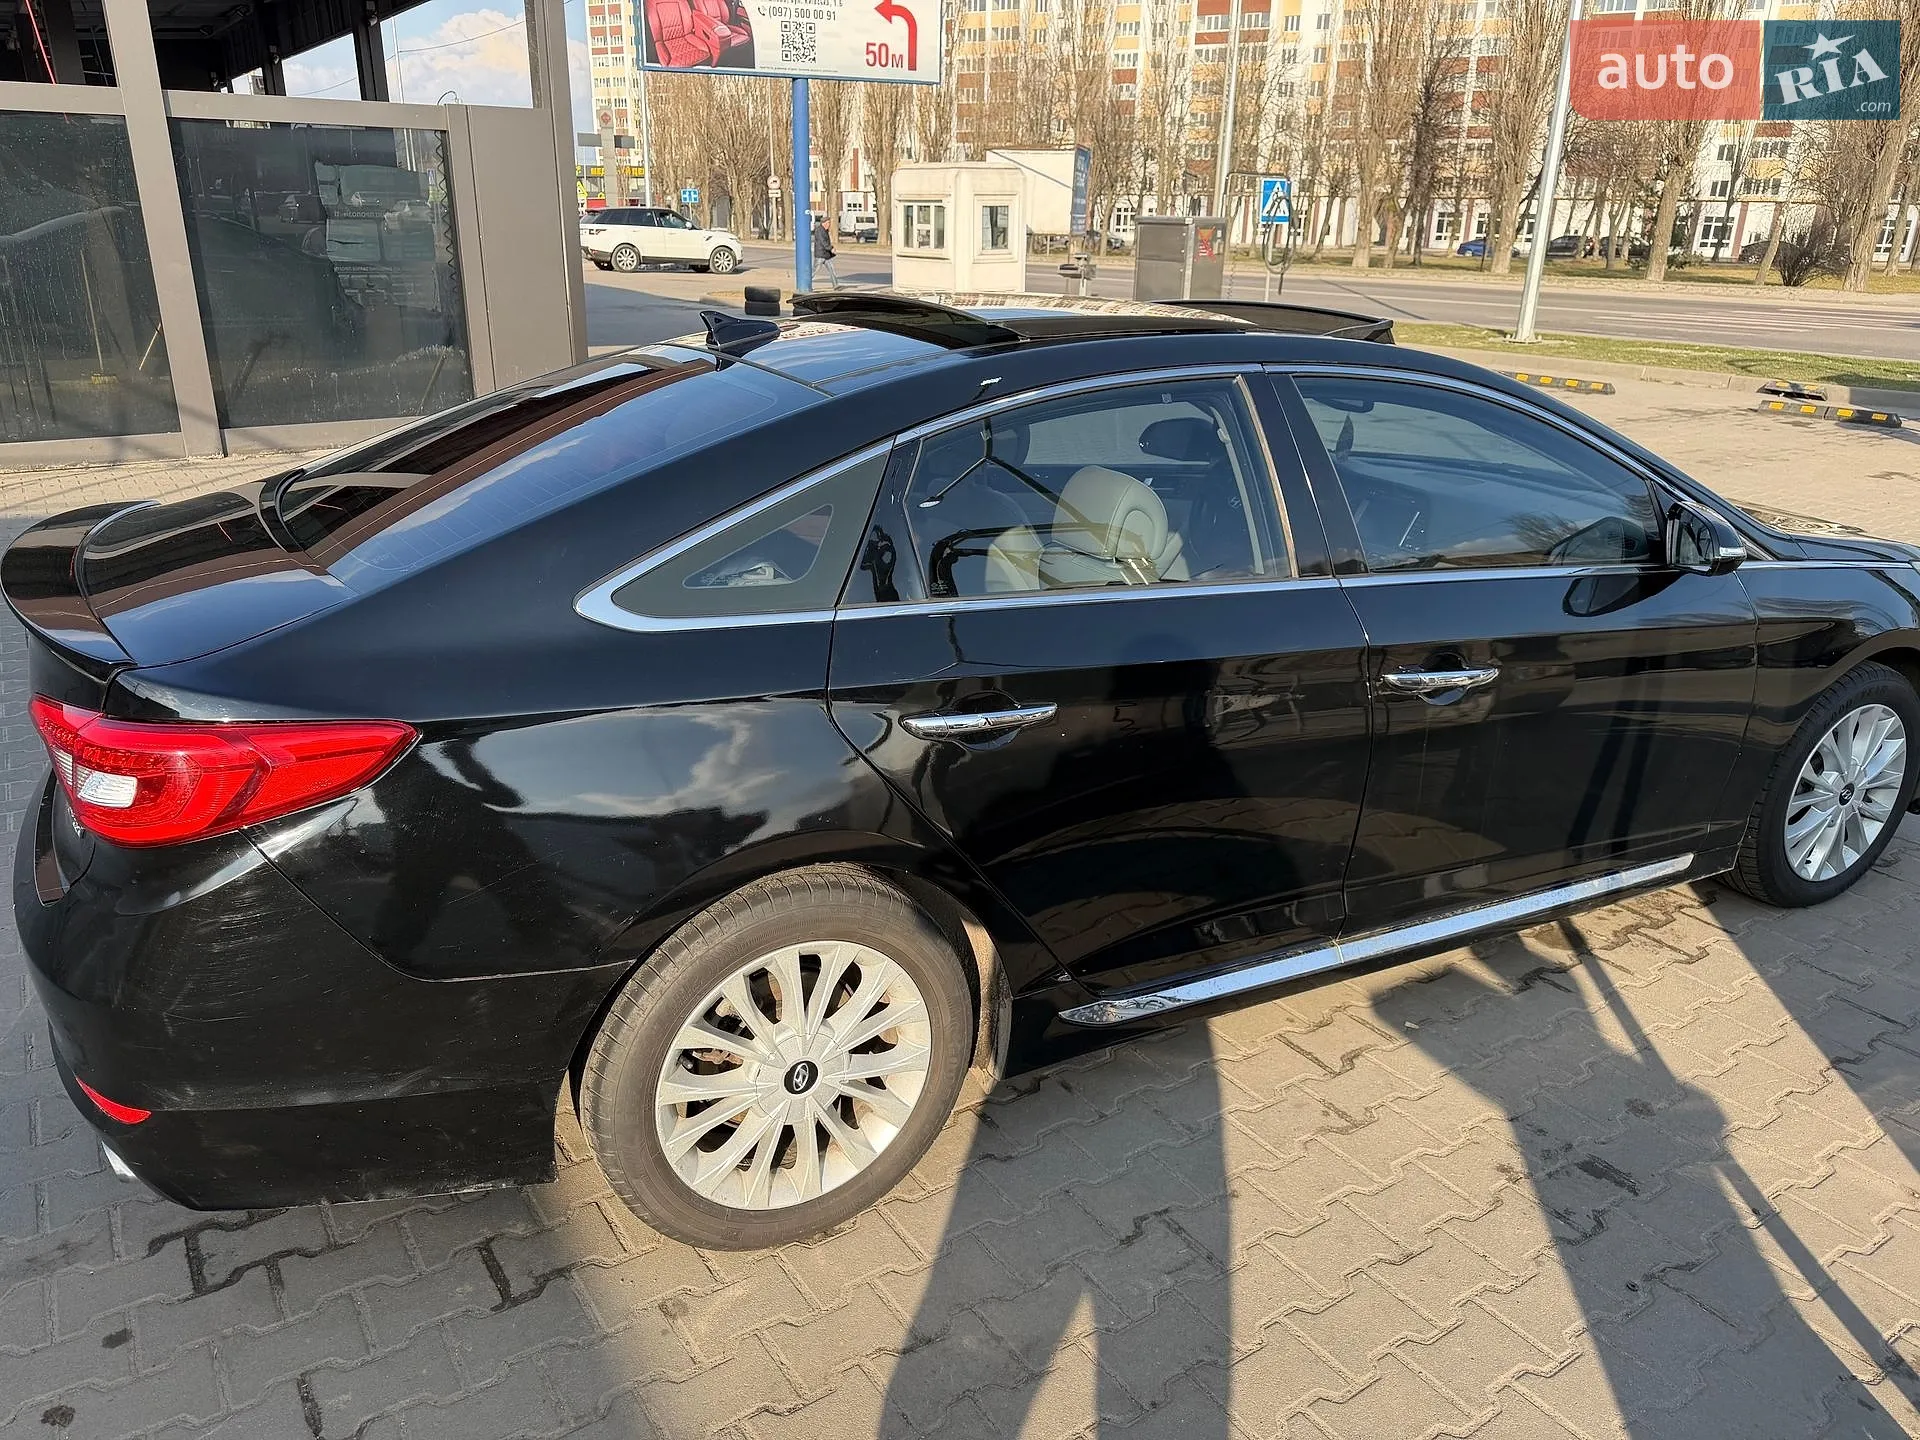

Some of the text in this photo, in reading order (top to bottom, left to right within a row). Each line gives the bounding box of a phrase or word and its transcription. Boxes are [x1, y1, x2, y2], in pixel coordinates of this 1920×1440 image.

[768, 6, 837, 21] (097) 500 00 91
